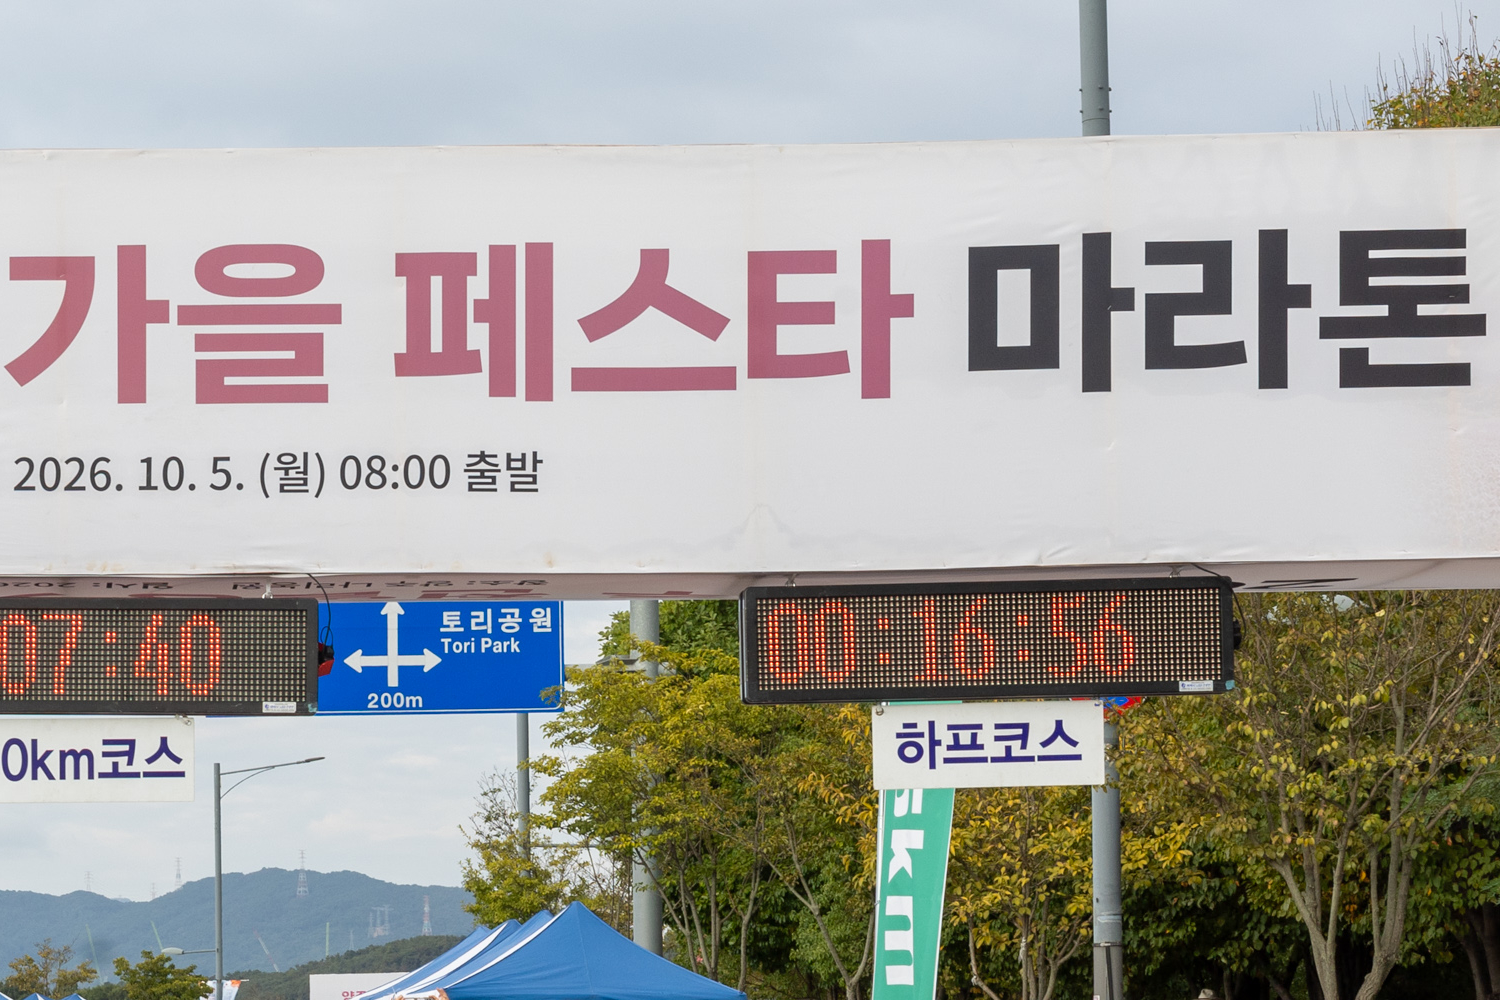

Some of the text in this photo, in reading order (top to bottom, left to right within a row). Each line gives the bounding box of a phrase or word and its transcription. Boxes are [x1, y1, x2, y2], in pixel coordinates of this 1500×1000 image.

[4, 243, 342, 405] 가을
[393, 238, 915, 402] 페스타
[968, 227, 1487, 393] 마라톤
[13, 455, 124, 493] 2026.
[136, 454, 196, 493] 10.
[209, 454, 246, 493] 5.
[257, 451, 325, 499] (월)
[339, 452, 450, 490] 08:00
[464, 449, 544, 494] 출발
[440, 607, 552, 634] 토리공원
[440, 637, 521, 654] Tori Park
[766, 595, 1134, 684] 00:16:56
[367, 692, 423, 708] 200m
[895, 719, 1083, 770] 하프코스
